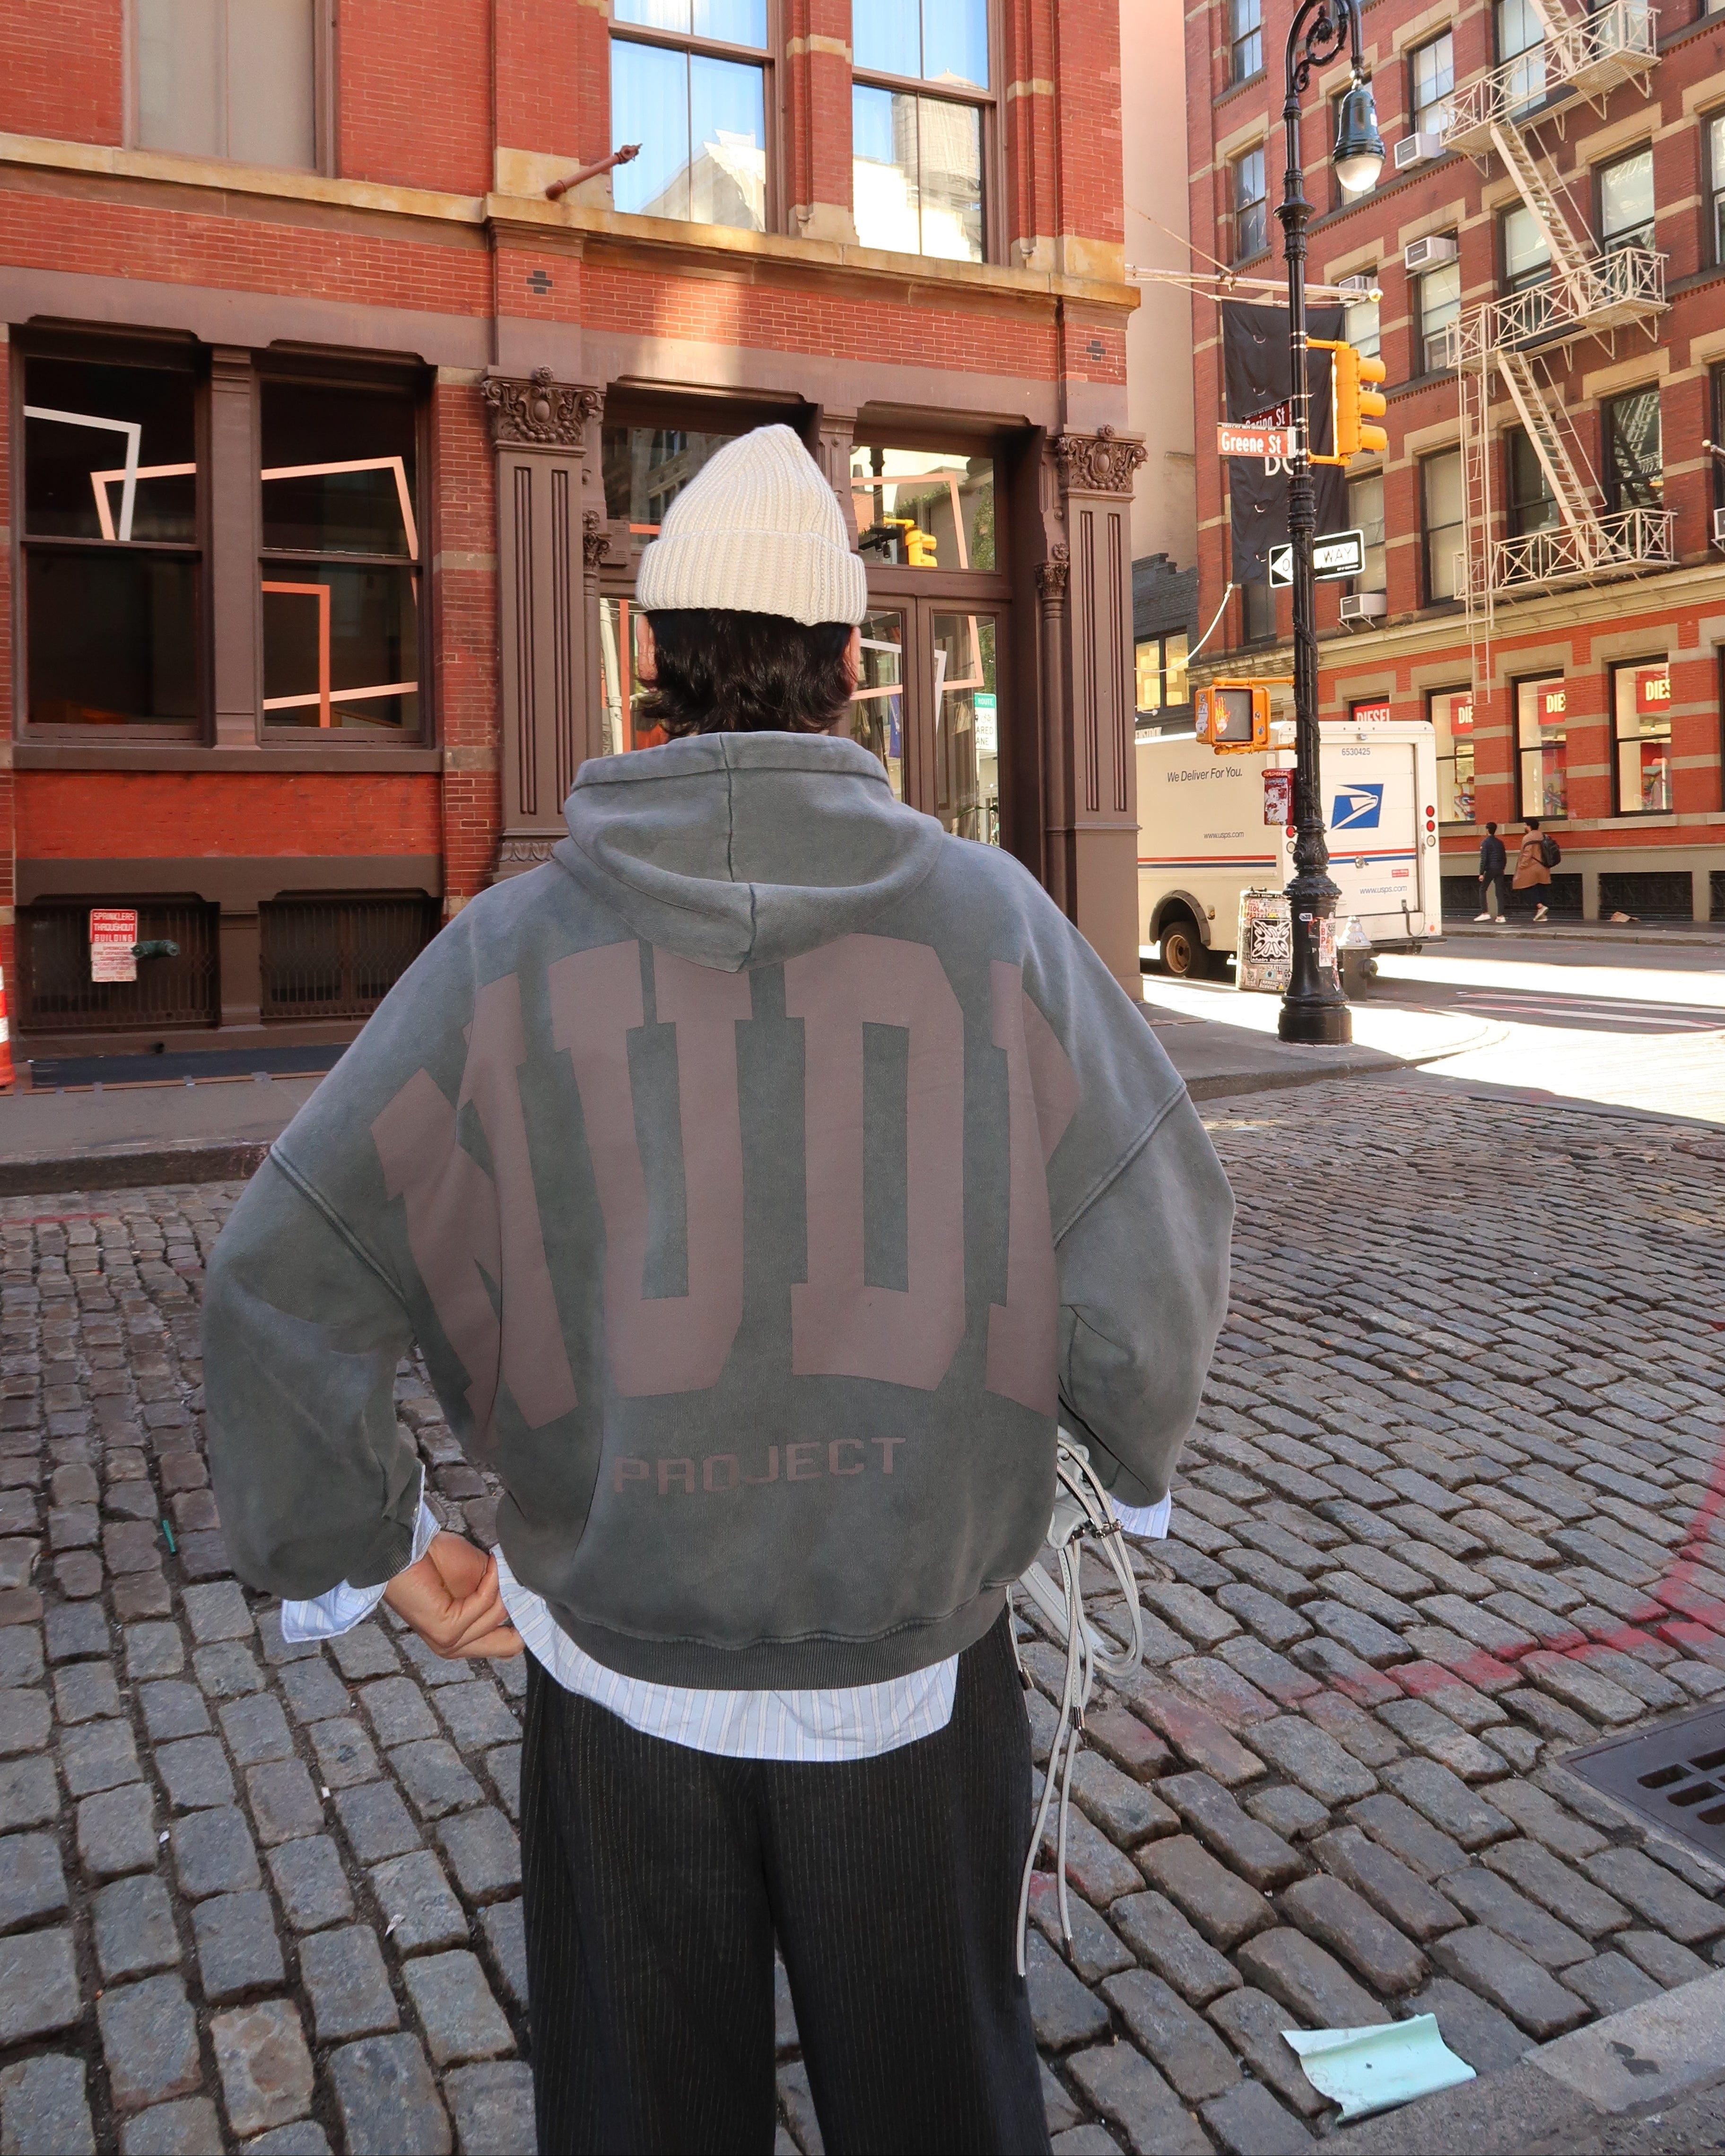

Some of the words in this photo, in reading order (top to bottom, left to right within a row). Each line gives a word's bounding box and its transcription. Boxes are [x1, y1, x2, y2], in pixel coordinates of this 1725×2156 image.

[1276, 407, 1285, 426] St
[1221, 431, 1264, 453] Greene
[1268, 434, 1281, 454] St
[1324, 546, 1352, 564] WAY
[977, 697, 993, 706] ROUTE
[1546, 693, 1566, 713] DIE
[1342, 748, 1371, 756] 6530425
[1167, 771, 1180, 782] We
[1181, 770, 1209, 781] Deliver
[1210, 768, 1224, 779] For
[1225, 766, 1243, 778] You.
[1203, 832, 1245, 840] www.usps.com
[1359, 886, 1407, 894] www.usps.com
[93, 913, 135, 921] SPRINKLERS
[93, 923, 135, 931] THROUGHOUT
[95, 934, 133, 942] BUILDING
[613, 1437, 906, 1495] PROJECT
